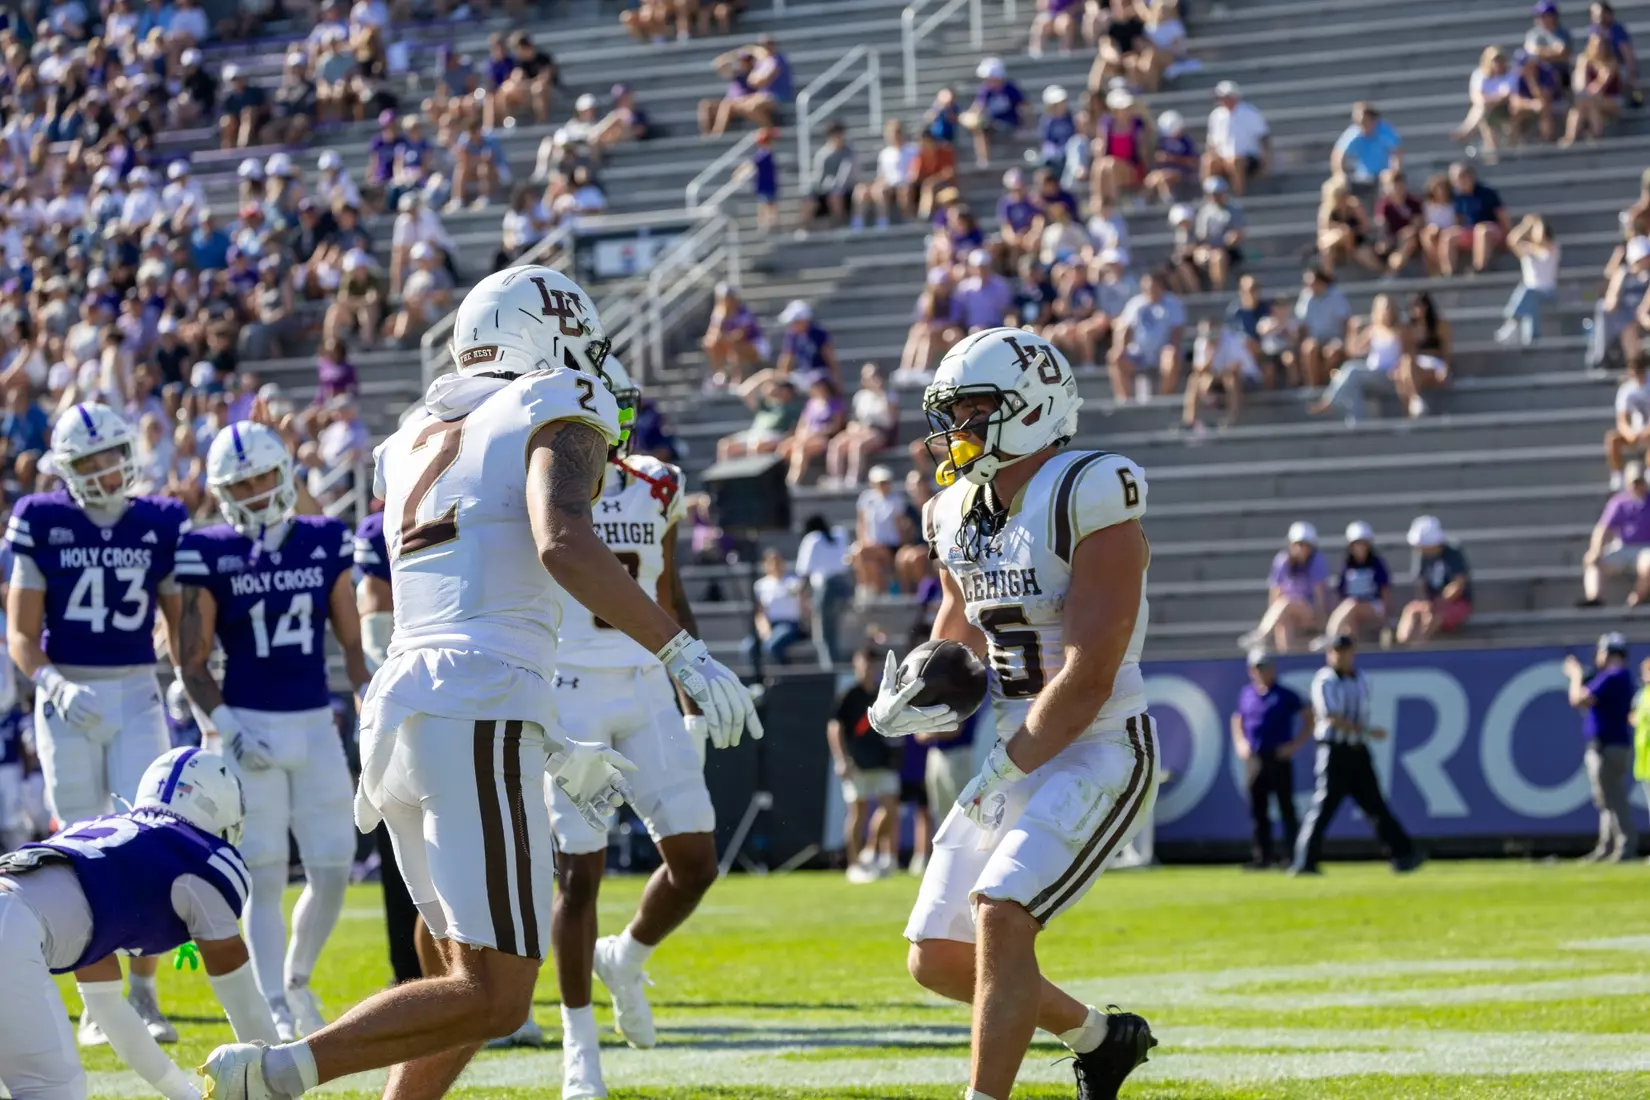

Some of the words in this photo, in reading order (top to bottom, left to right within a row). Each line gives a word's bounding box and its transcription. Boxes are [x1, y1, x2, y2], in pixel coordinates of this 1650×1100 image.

[473, 327, 478, 341] 2
[460, 353, 472, 364] THE
[473, 349, 492, 358] NEST
[575, 377, 600, 414] 2
[400, 417, 466, 556] 2
[1116, 466, 1139, 510] 6
[60, 547, 100, 569] HOLY
[101, 546, 152, 570] CROSS
[230, 571, 271, 596] HOLY
[273, 565, 324, 592] CROSS
[960, 567, 1043, 603] LEHIGH
[63, 566, 149, 633] 43
[249, 592, 315, 658] 14
